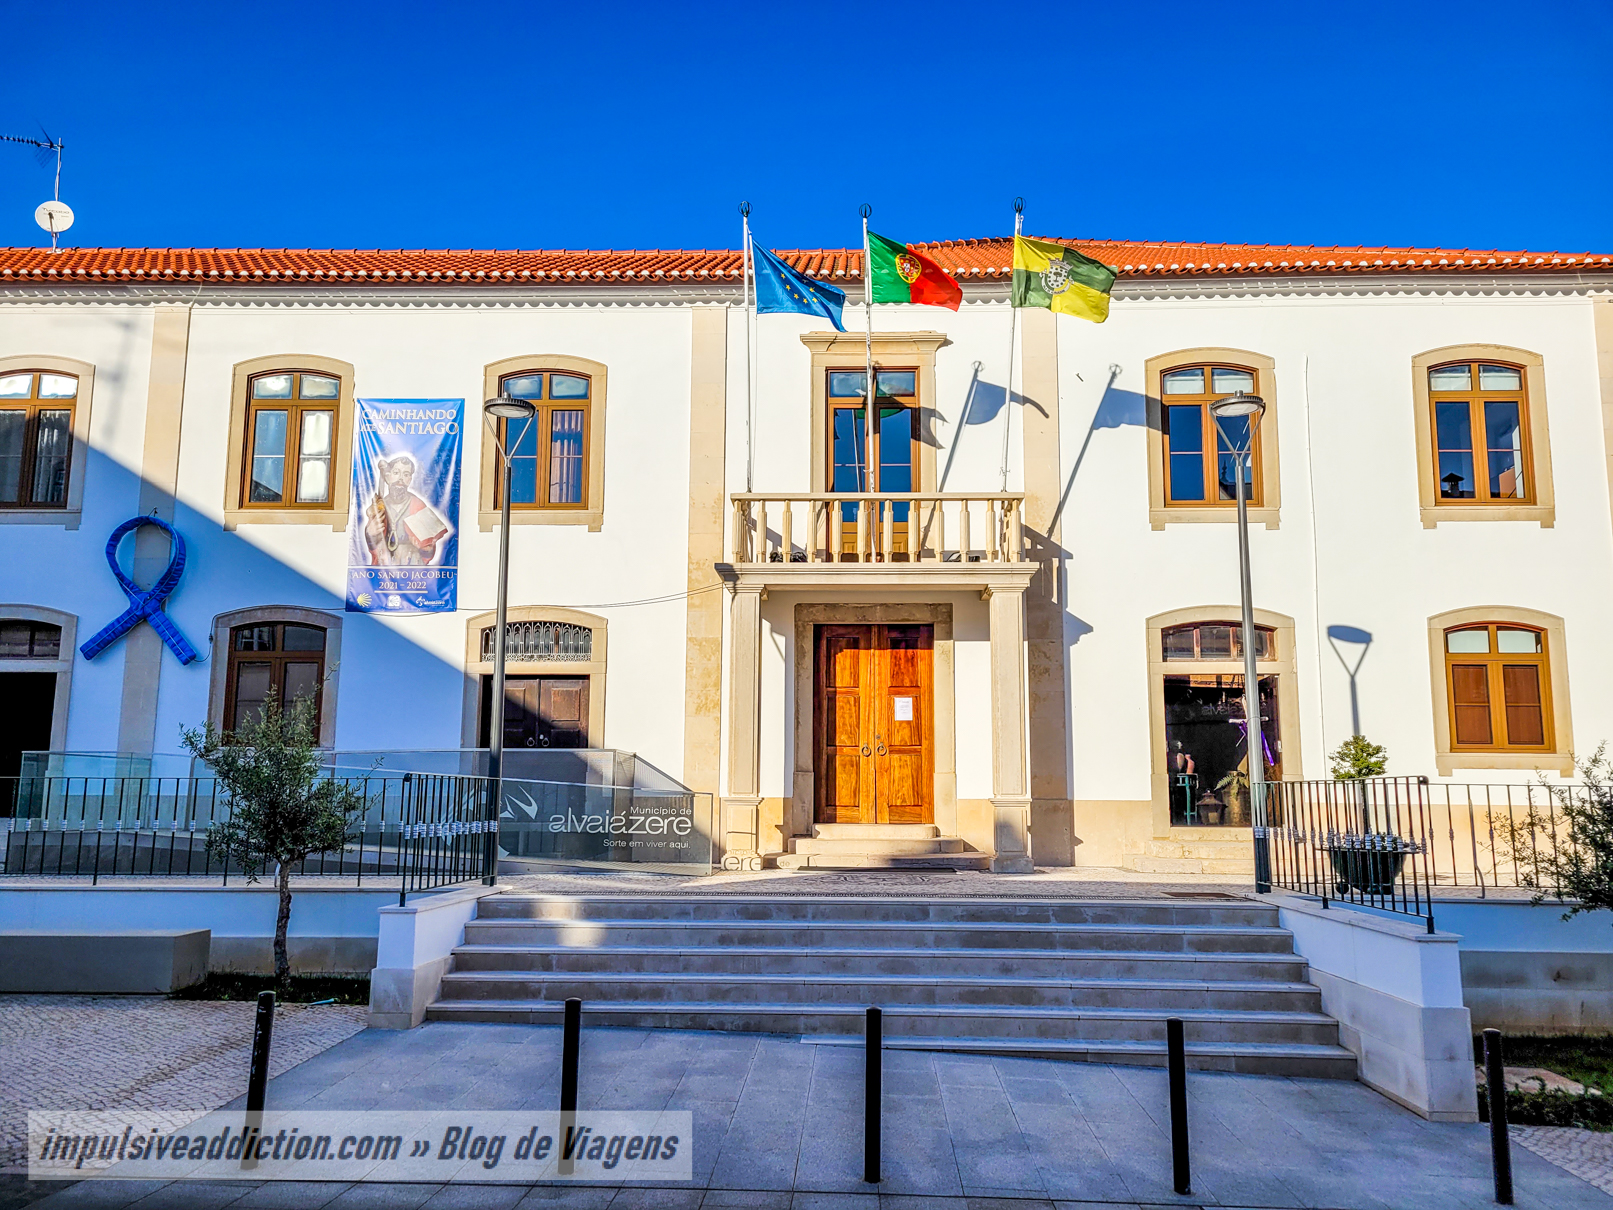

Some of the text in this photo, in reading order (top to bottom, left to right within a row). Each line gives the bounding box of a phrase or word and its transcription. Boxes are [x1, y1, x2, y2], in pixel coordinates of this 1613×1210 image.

[362, 409, 457, 420] CAMINHANDO
[377, 421, 459, 435] SANTIAGO
[352, 570, 454, 580] ANO SANTO JACOBEU
[379, 581, 398, 590] 2021
[406, 581, 427, 590] 2022
[630, 806, 692, 816] Município de
[548, 807, 692, 836] alvaiázere
[603, 839, 627, 848] Sorte
[646, 840, 667, 848] viver
[669, 841, 691, 850] aqui.
